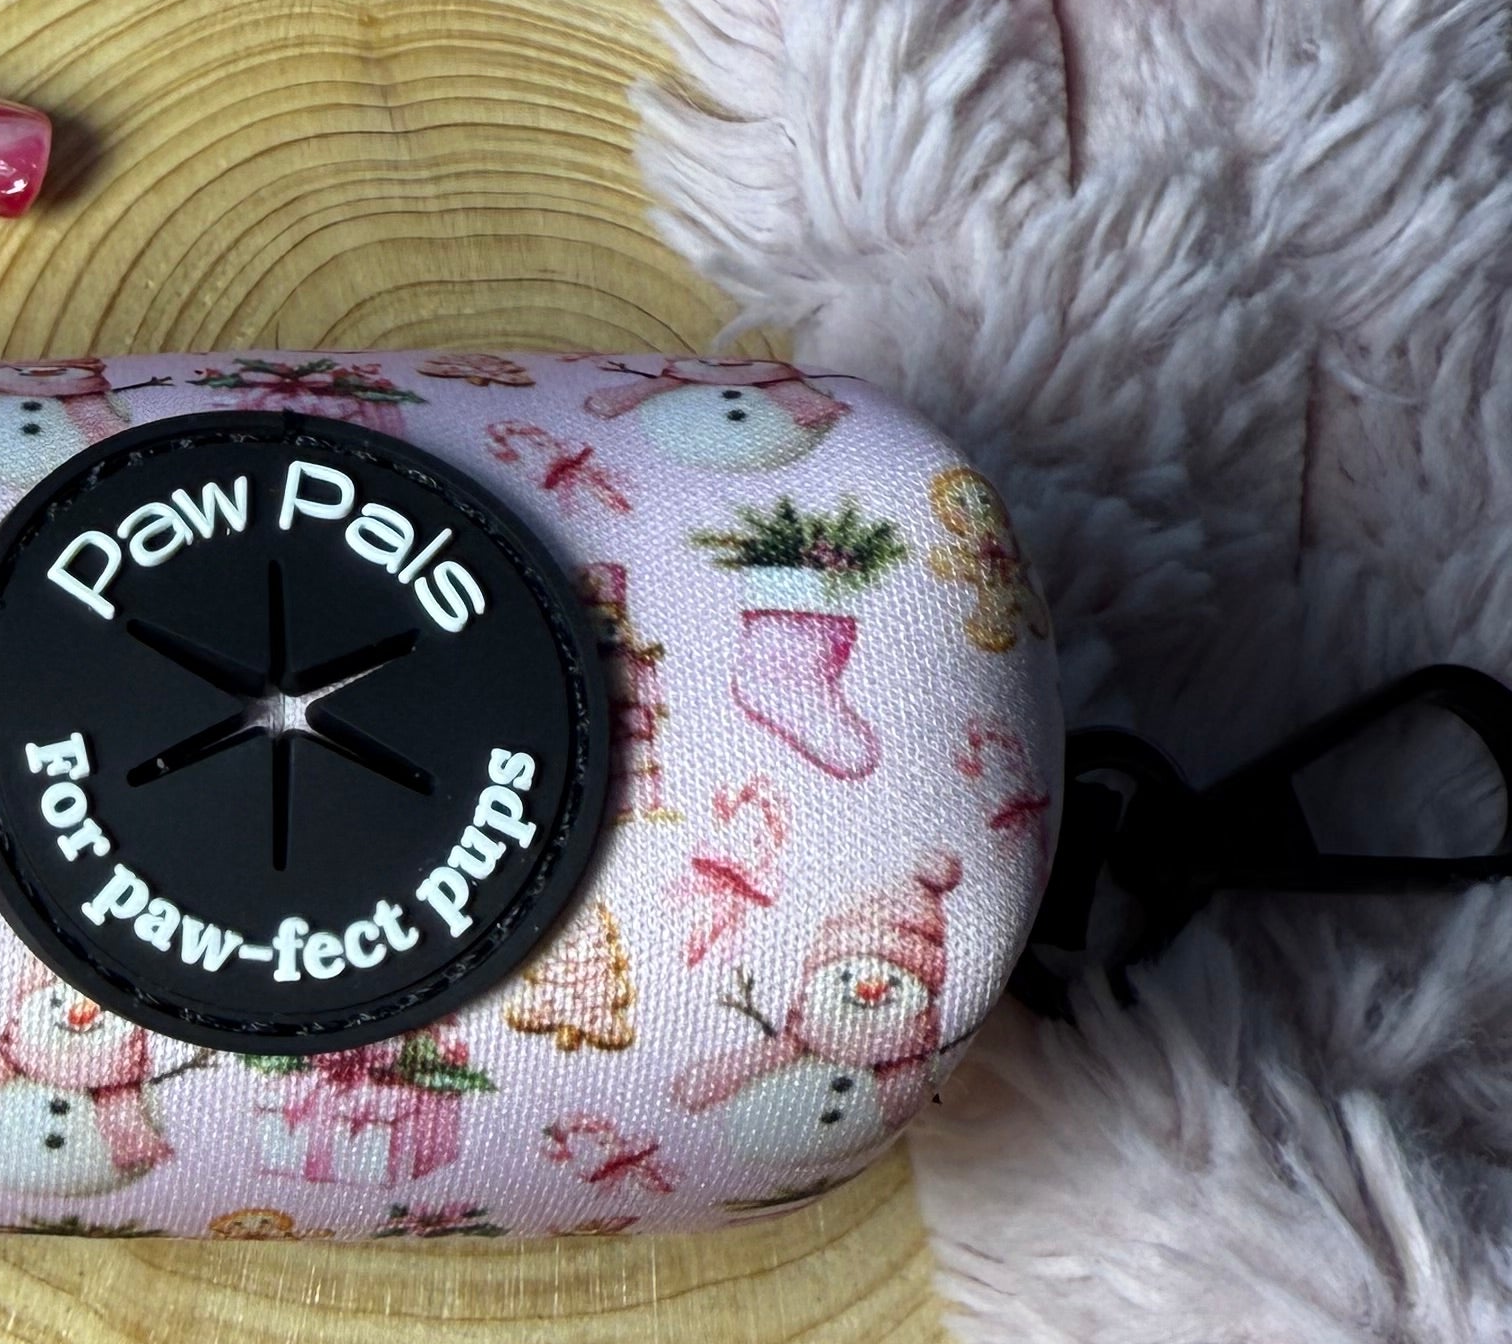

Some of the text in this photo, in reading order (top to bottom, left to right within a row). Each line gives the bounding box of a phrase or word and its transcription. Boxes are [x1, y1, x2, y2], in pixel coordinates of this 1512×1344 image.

[46, 459, 487, 634] Paw Pals
[24, 731, 538, 983] For paw-fect pups
